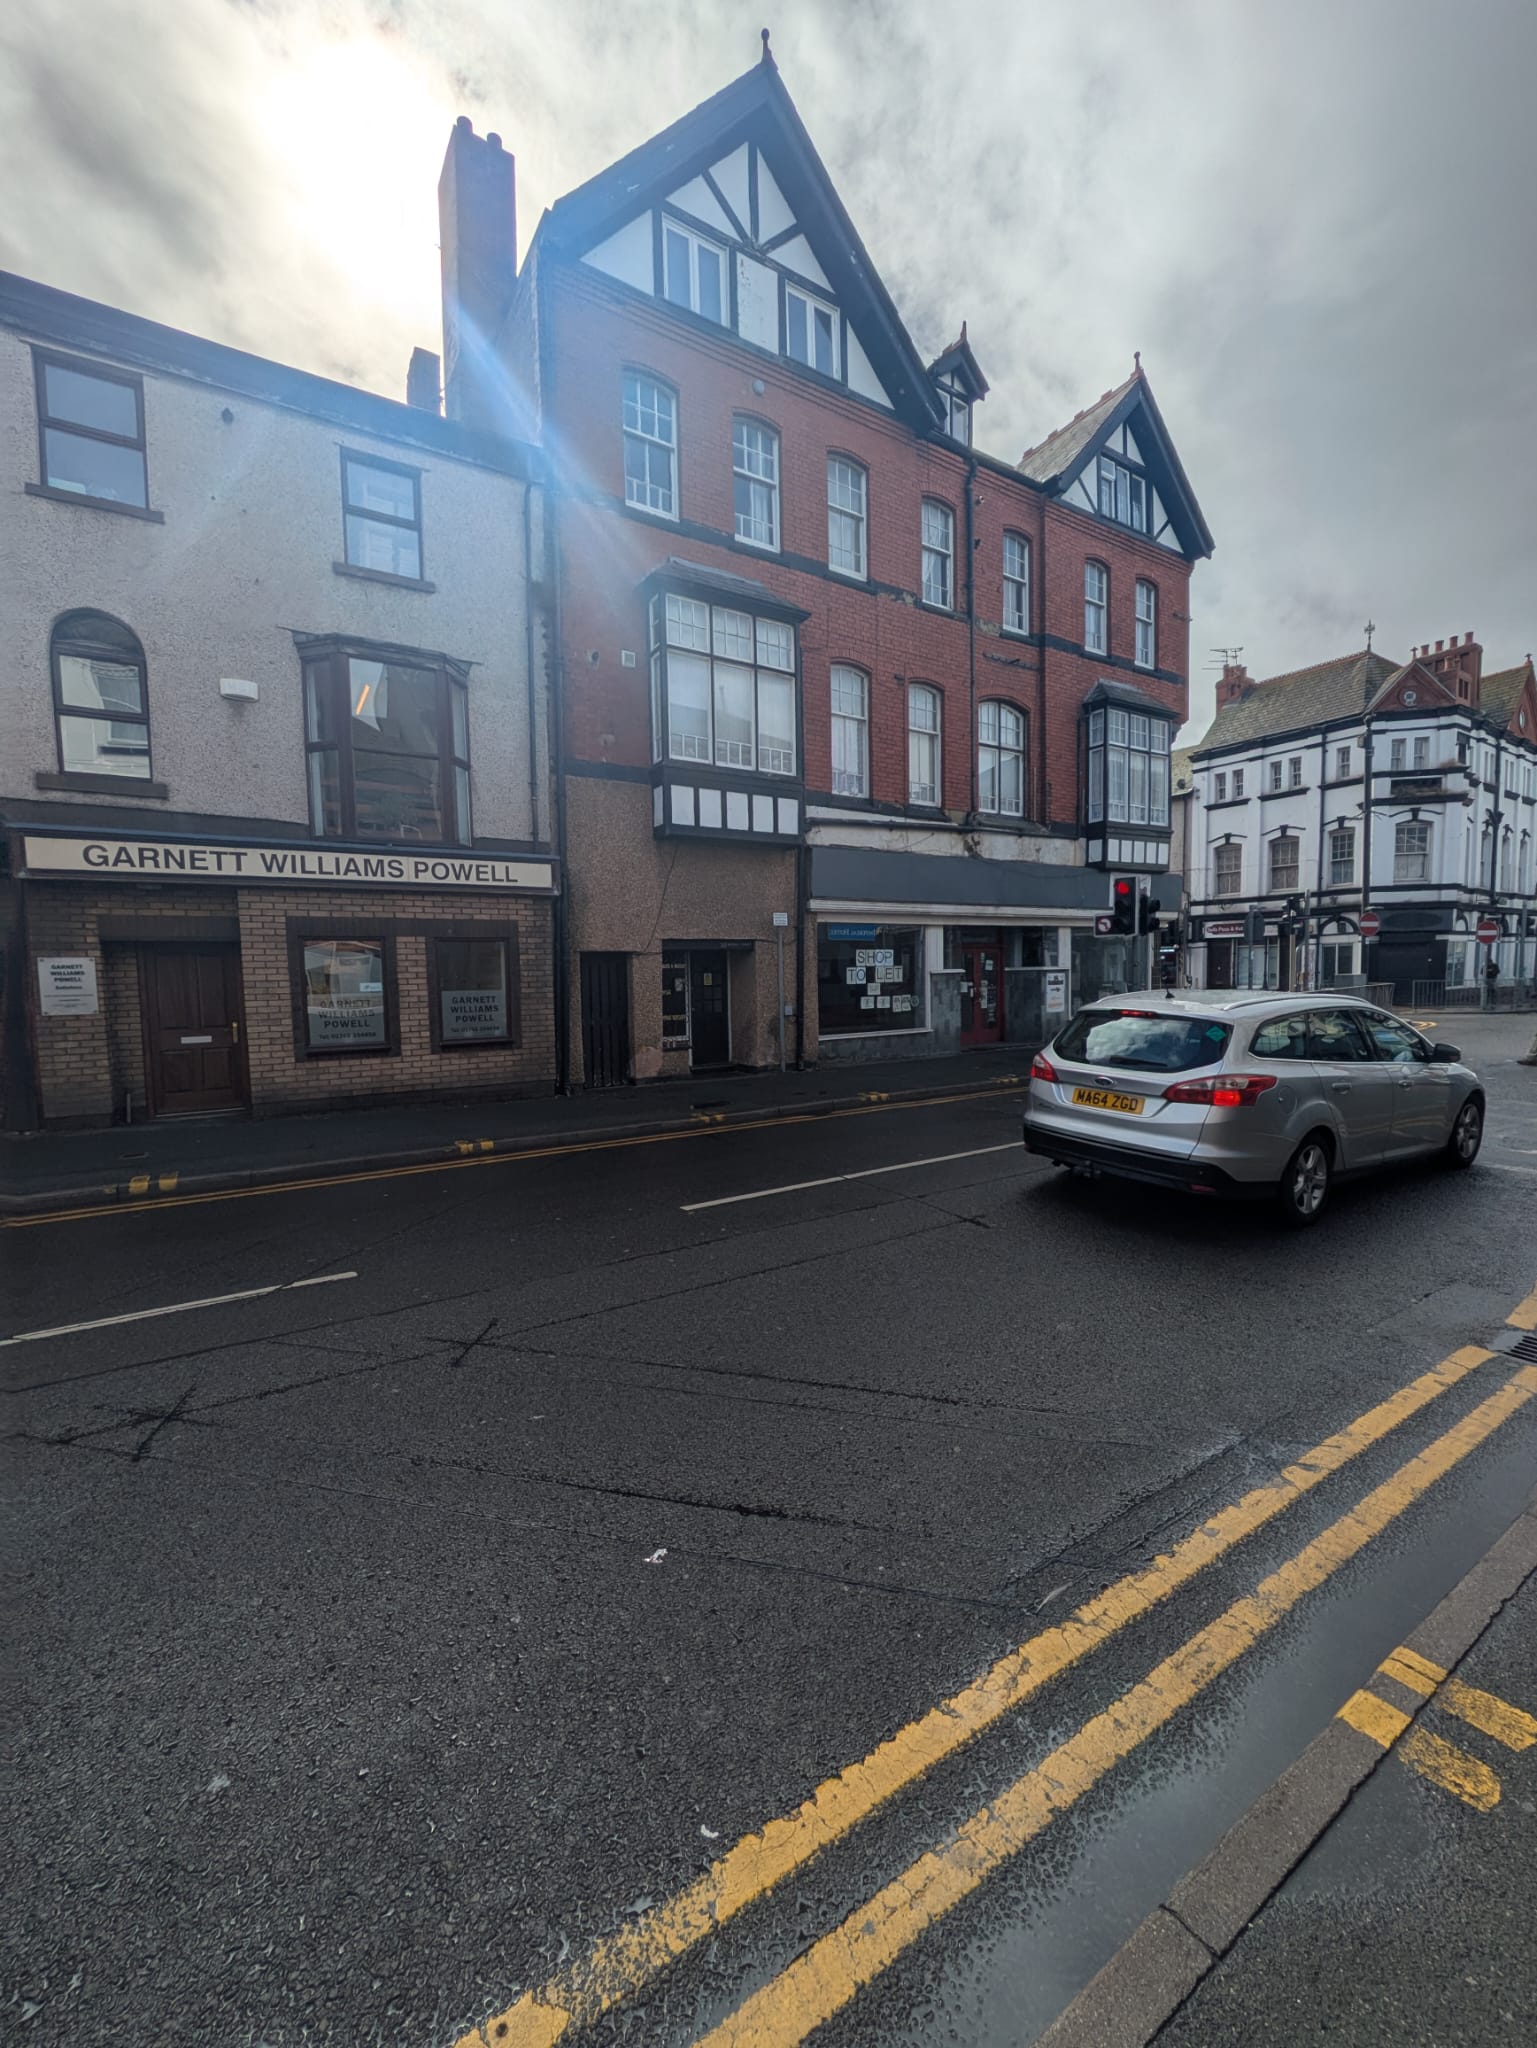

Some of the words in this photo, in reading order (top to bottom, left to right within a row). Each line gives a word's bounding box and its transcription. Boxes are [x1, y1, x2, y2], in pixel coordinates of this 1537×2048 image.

[83, 844, 248, 872] GARNETT
[260, 852, 404, 879] WILLIAMS
[414, 861, 518, 882] POWELL
[857, 951, 893, 964] SHOP
[848, 968, 866, 981] TO
[877, 967, 902, 980] LET
[320, 1000, 370, 1008] GARNETT
[452, 996, 496, 1004] GARNETT
[319, 1009, 375, 1018] WILLIAMS
[450, 1005, 499, 1013] WILLIAMS
[324, 1020, 371, 1028] POWELL
[1077, 1091, 1107, 1106] MA64
[1112, 1097, 1138, 1111] ZGD
